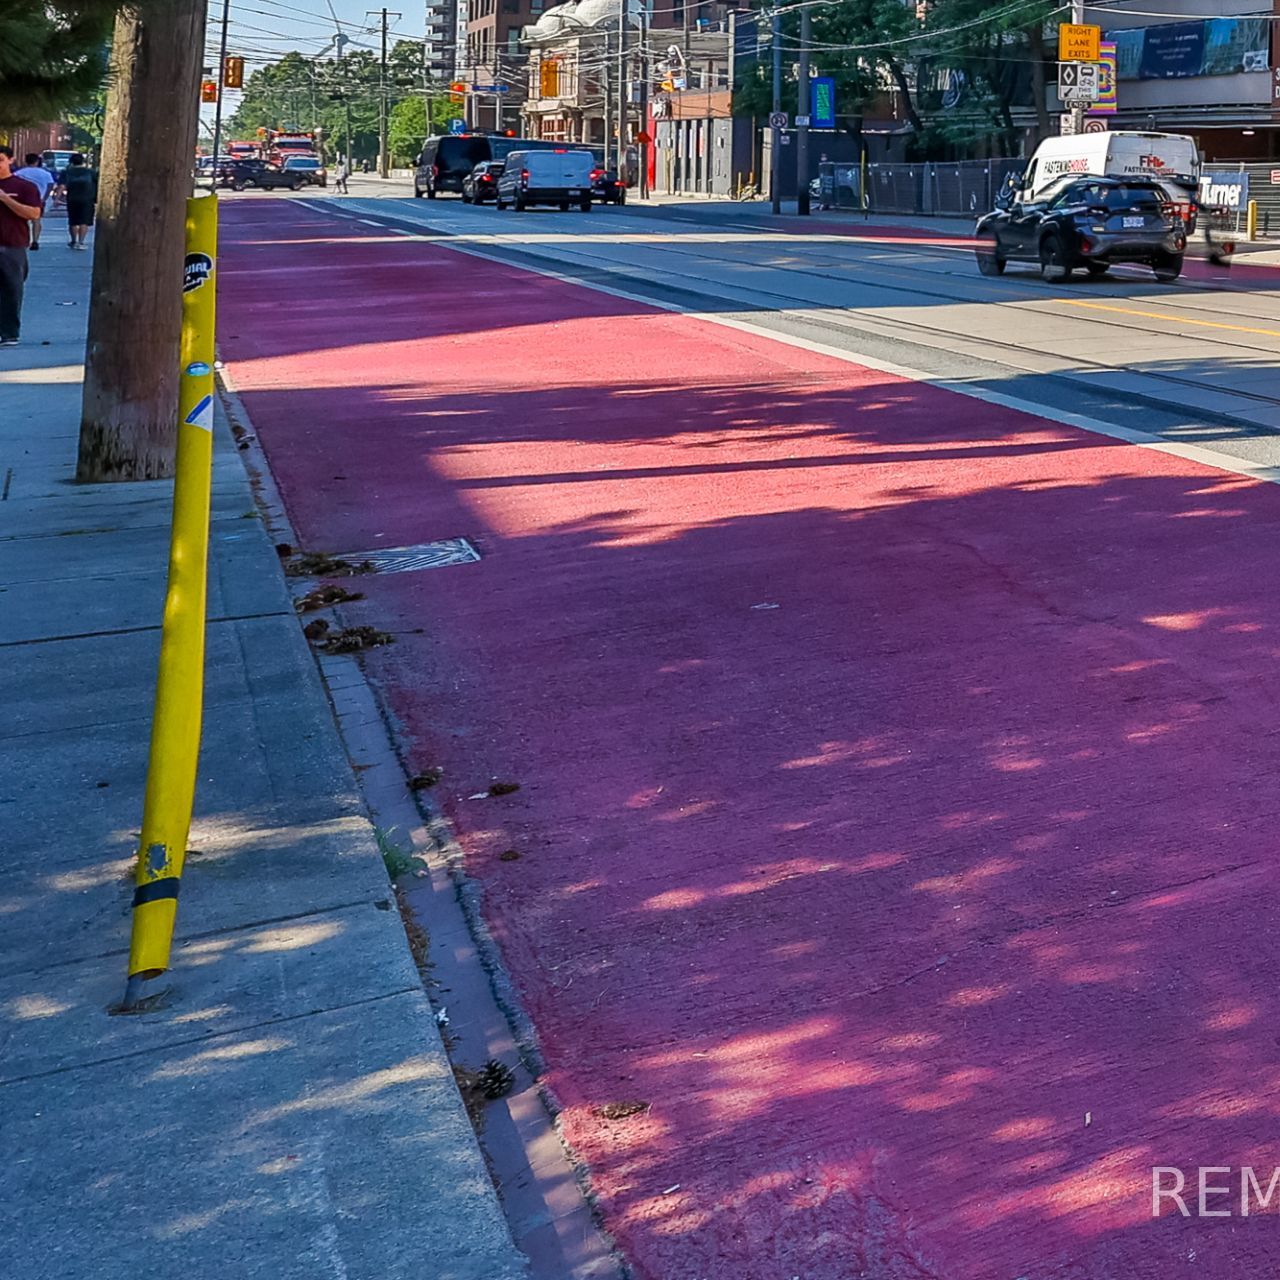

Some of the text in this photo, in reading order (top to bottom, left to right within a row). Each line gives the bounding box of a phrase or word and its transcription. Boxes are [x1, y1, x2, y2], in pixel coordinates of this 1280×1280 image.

[1067, 27, 1092, 36] RIGHT
[1068, 39, 1090, 47] LANE
[1068, 50, 1090, 58] EXITS
[1069, 101, 1089, 109] ENDS
[1199, 176, 1242, 207] Turner
